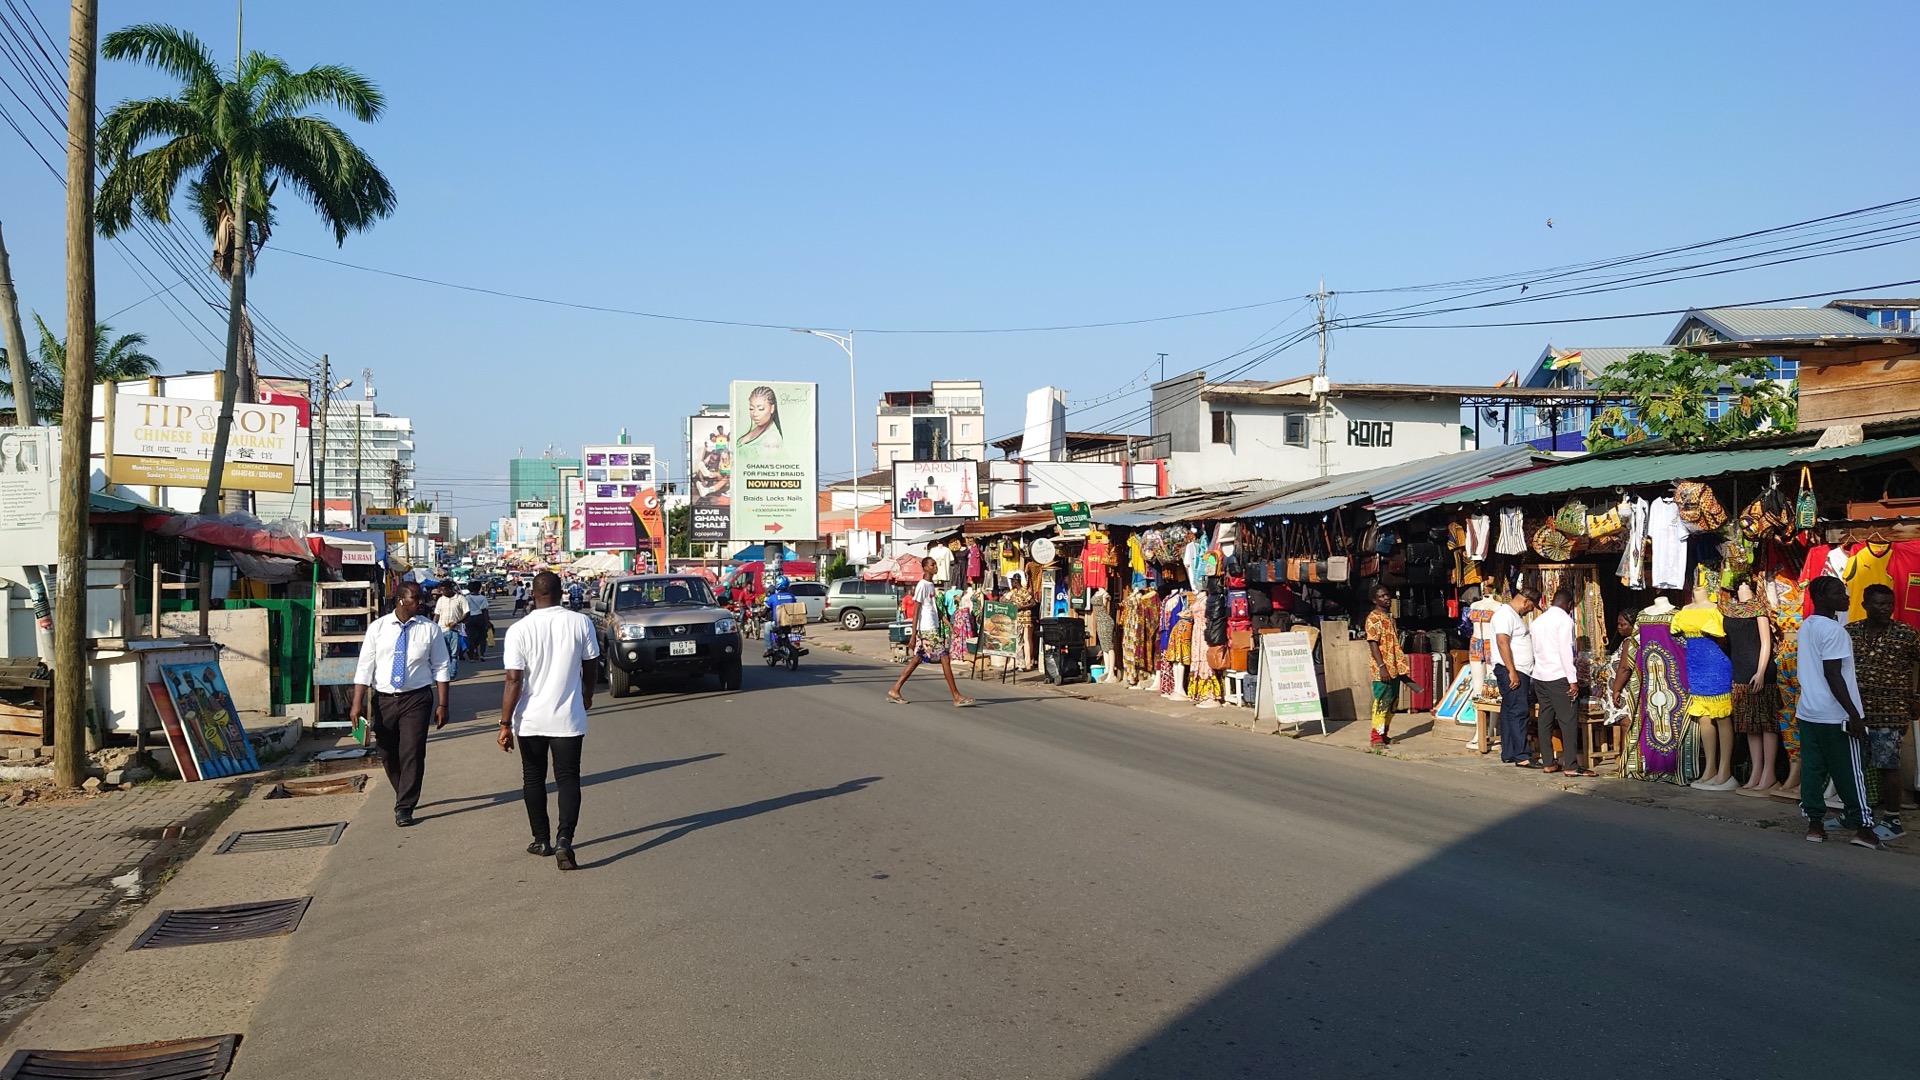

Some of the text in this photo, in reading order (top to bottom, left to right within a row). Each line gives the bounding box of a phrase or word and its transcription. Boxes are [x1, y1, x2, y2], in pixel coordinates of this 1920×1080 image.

[137, 403, 192, 428] TIP
[134, 428, 284, 449] CHINESE REAURANT
[748, 480, 800, 488] NOW IN OSU
